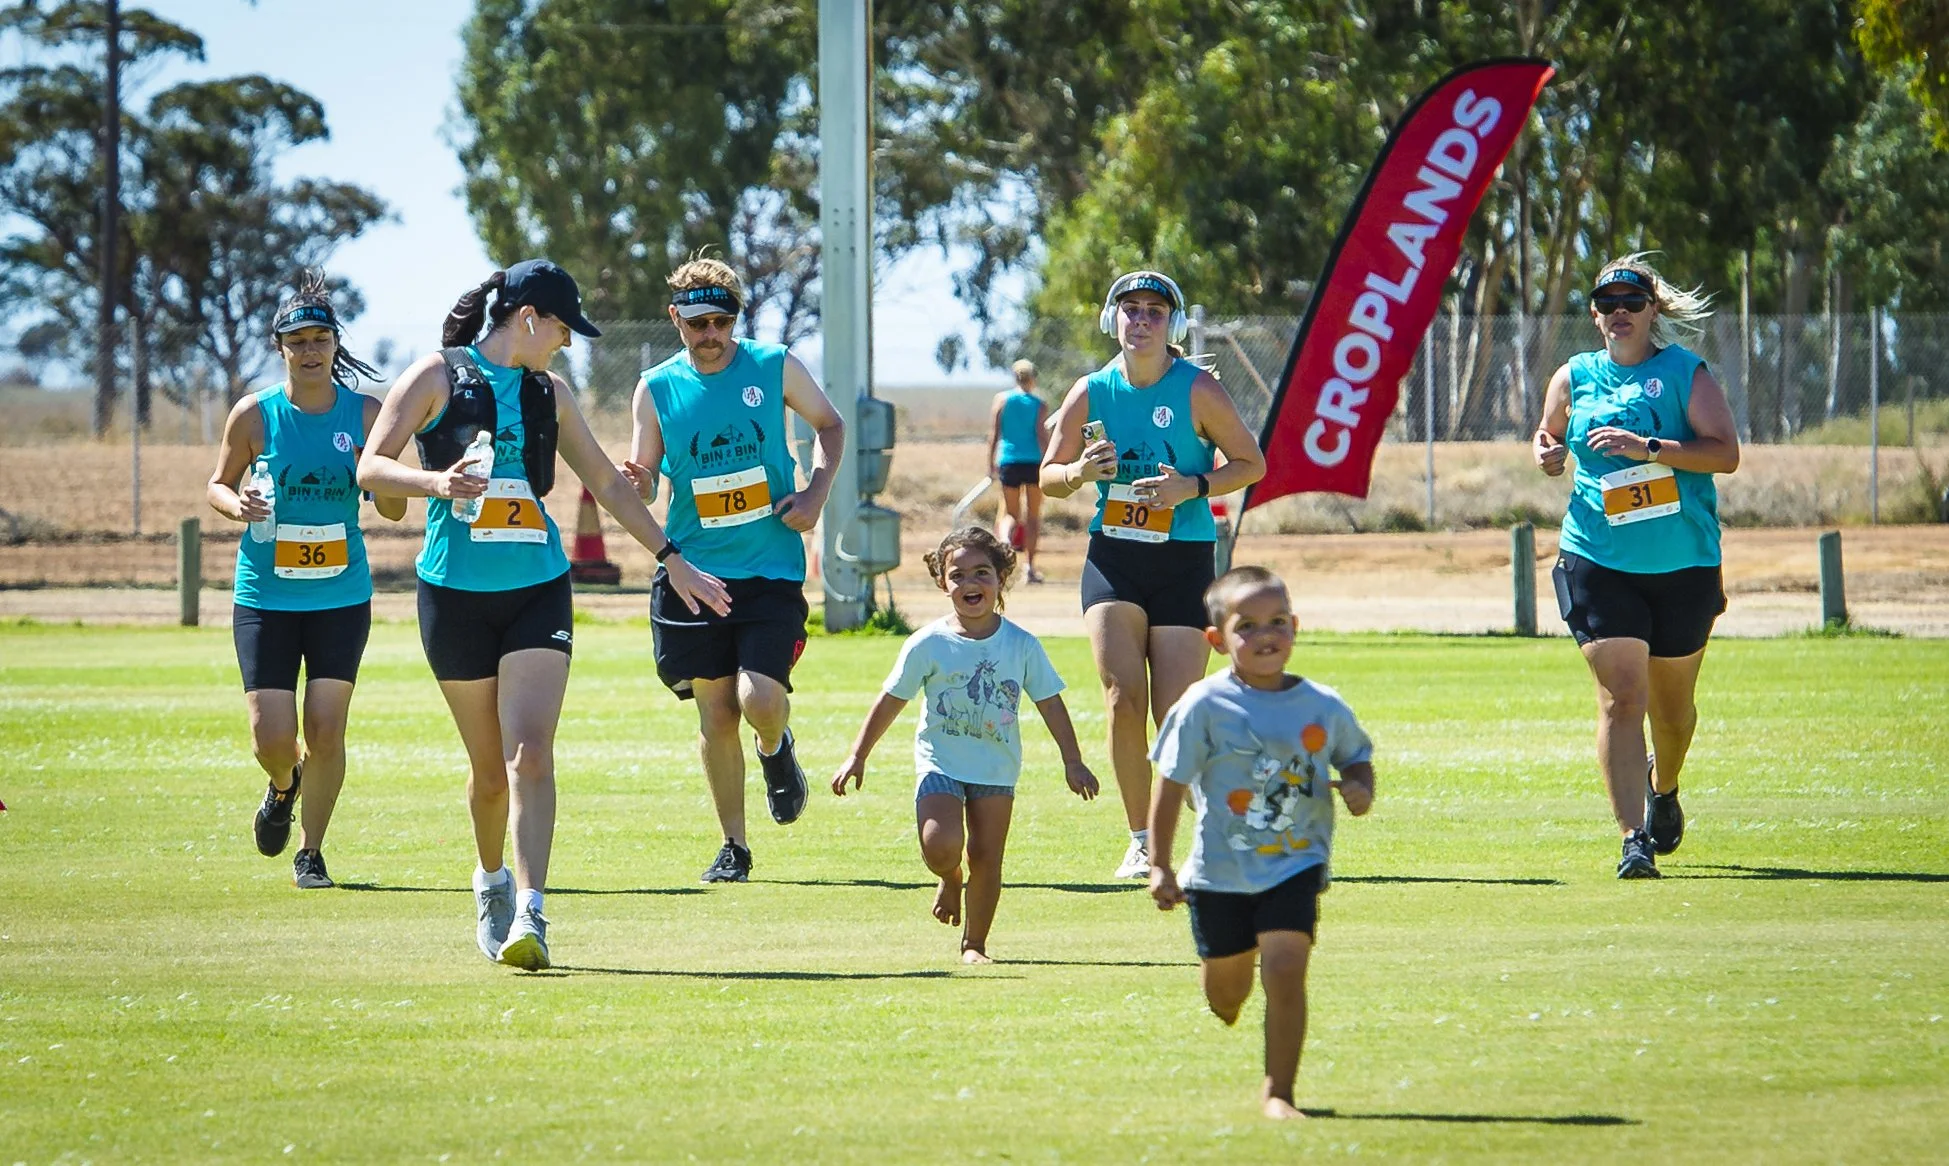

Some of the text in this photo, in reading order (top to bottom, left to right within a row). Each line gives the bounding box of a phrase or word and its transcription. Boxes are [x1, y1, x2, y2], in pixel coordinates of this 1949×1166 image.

[1303, 87, 1502, 468] CROPLANDS
[701, 443, 757, 465] BIN 2 BIN
[288, 486, 312, 496] BIN
[719, 490, 747, 513] 78
[1629, 483, 1652, 507] 31
[507, 500, 521, 526] 2
[1122, 503, 1149, 527] 30
[298, 544, 326, 566] 36
